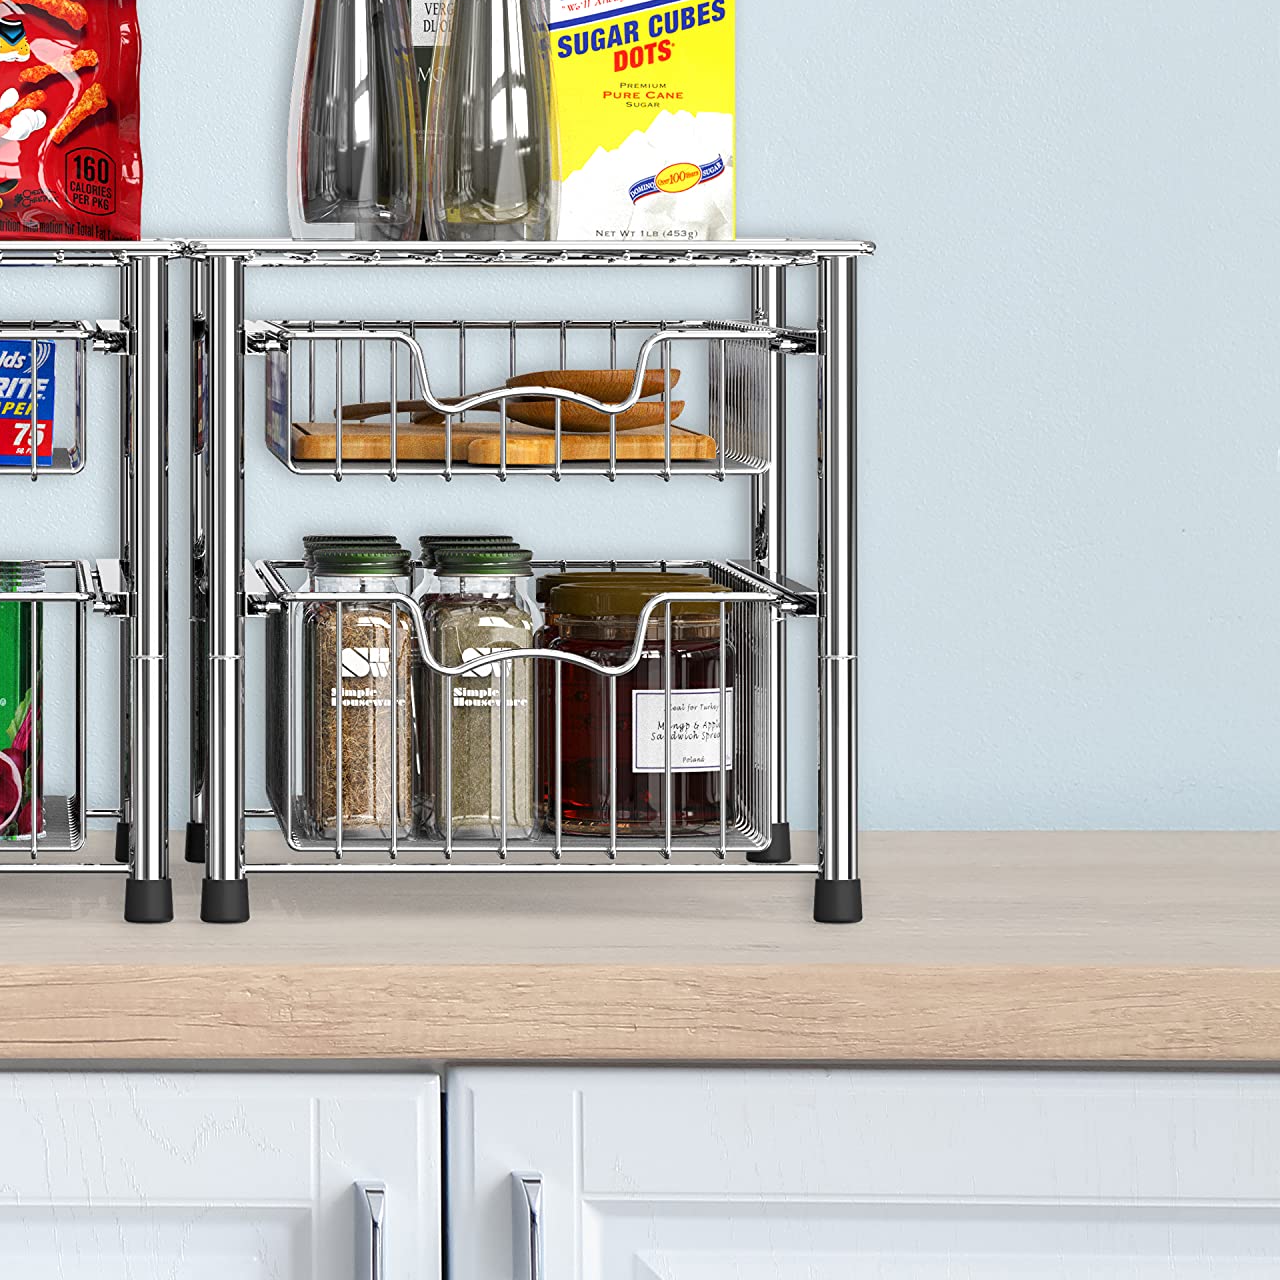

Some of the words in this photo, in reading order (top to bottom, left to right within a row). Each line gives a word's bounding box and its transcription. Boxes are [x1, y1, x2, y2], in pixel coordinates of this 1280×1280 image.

[557, 20, 639, 59] SUGAR
[613, 38, 672, 73] DOTS
[603, 90, 641, 100] PURE
[645, 90, 684, 100] CANE
[72, 154, 109, 184] 160
[630, 180, 656, 198] DOMINO
[669, 170, 686, 185] 100
[702, 161, 723, 176] SUGAR
[70, 180, 113, 199] CALORIES
[72, 193, 90, 206] PER
[91, 196, 109, 210] PKG
[76, 221, 94, 237] Total
[595, 229, 616, 237] NET
[619, 229, 636, 237] WT
[662, 229, 699, 240] (453g)
[13, 422, 47, 447] 75
[453, 687, 500, 698] Simple
[650, 730, 699, 741] Sadwich
